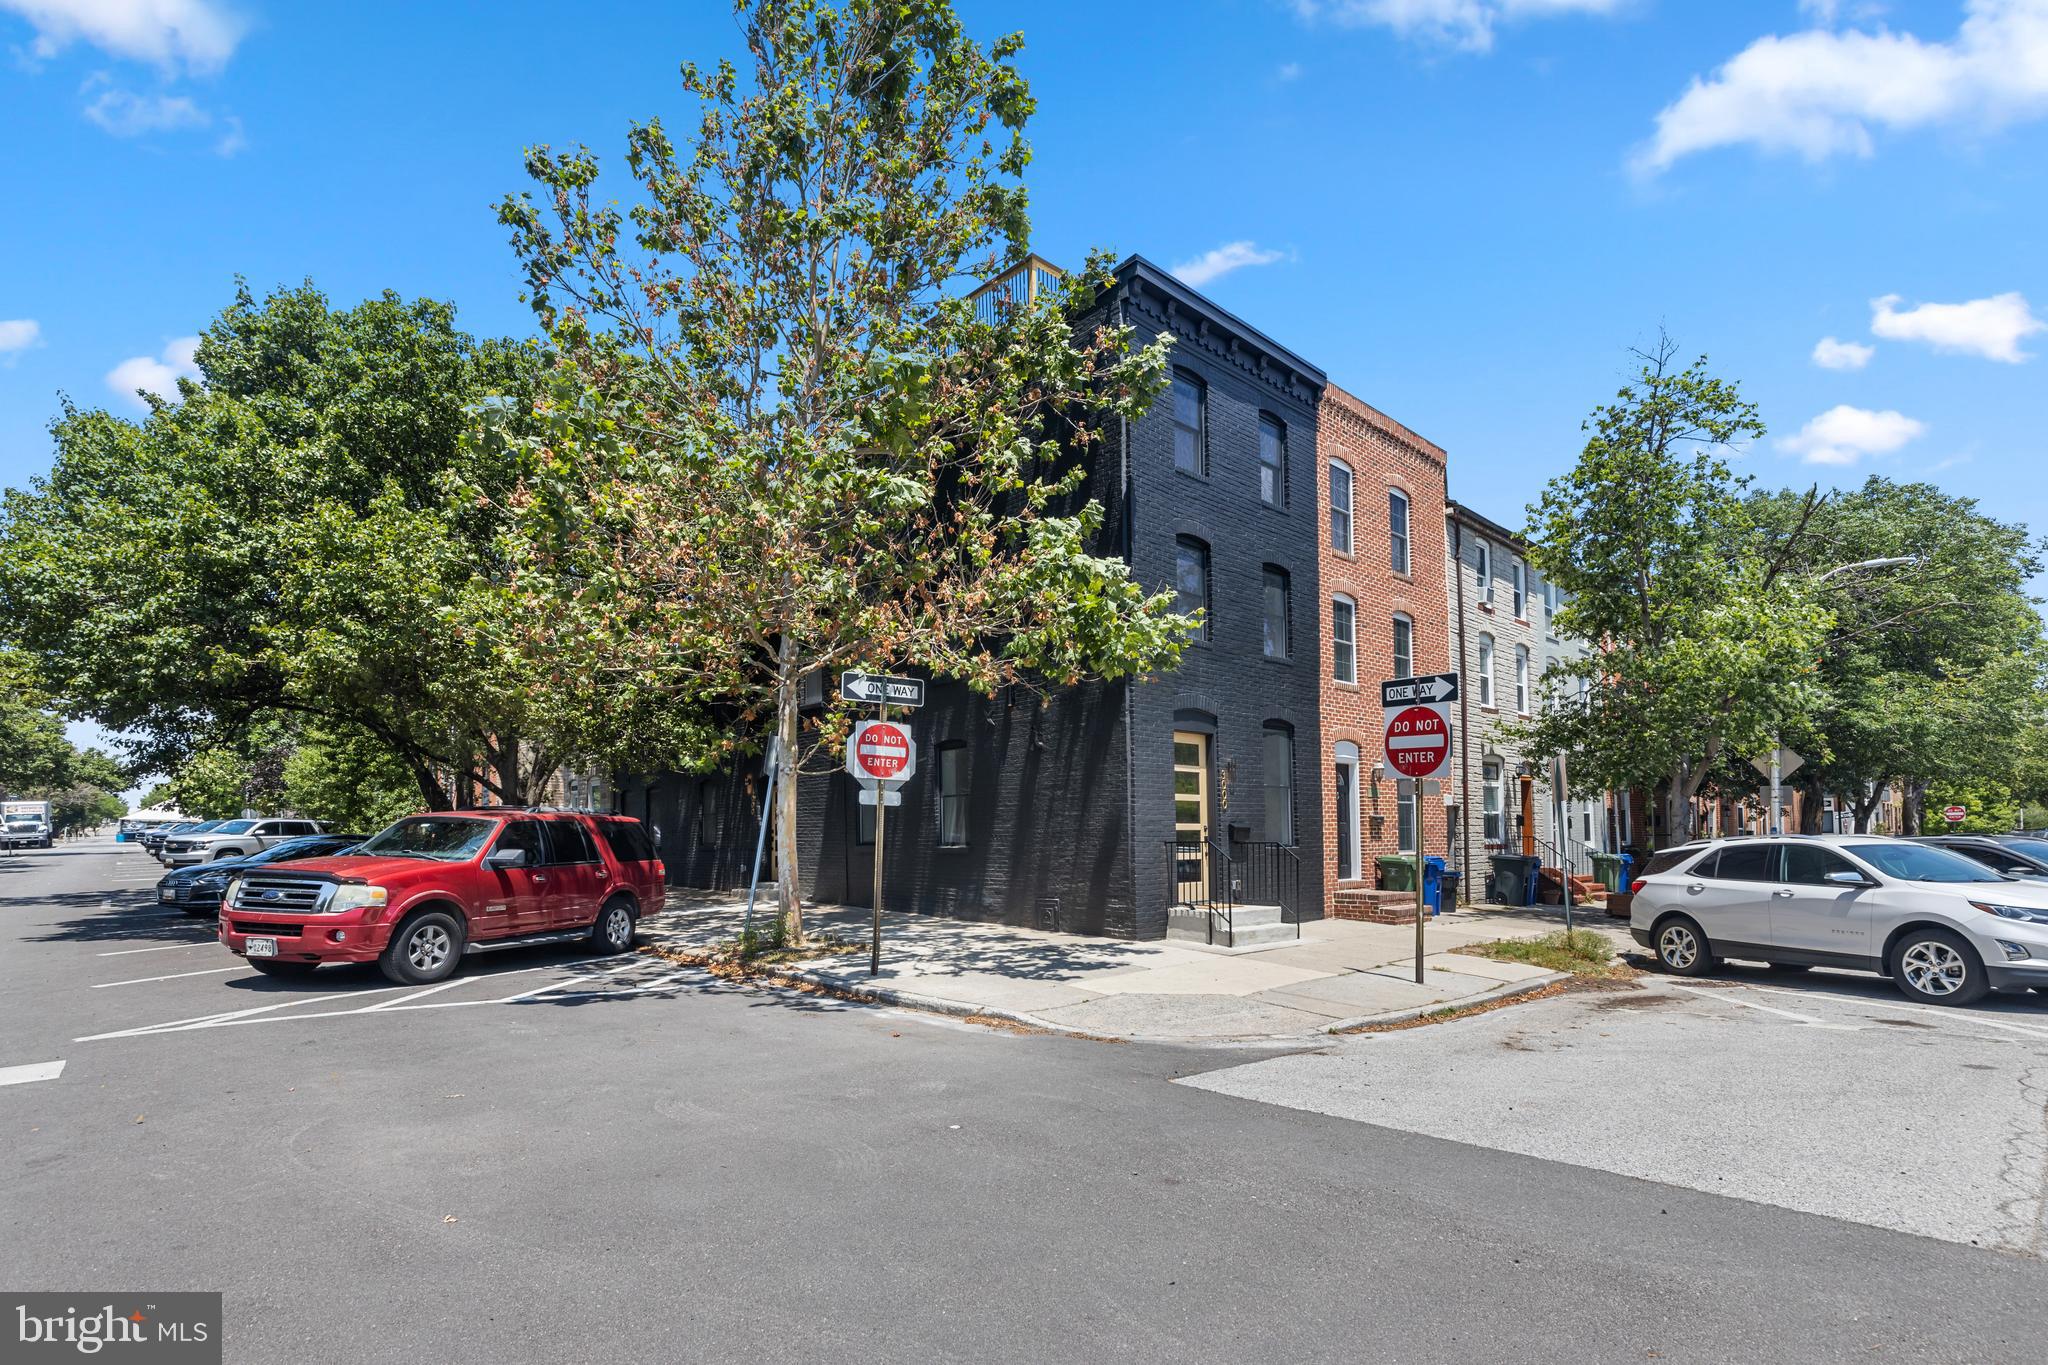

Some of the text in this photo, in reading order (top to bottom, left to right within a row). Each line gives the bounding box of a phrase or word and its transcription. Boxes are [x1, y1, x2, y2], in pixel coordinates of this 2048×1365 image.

[894, 685, 915, 697] WAY
[1389, 686, 1409, 699] ONE
[1394, 718, 1440, 733] DO NOT
[865, 733, 902, 745] DO NOT
[867, 757, 898, 768] ENTER
[1398, 751, 1435, 764] ENTER
